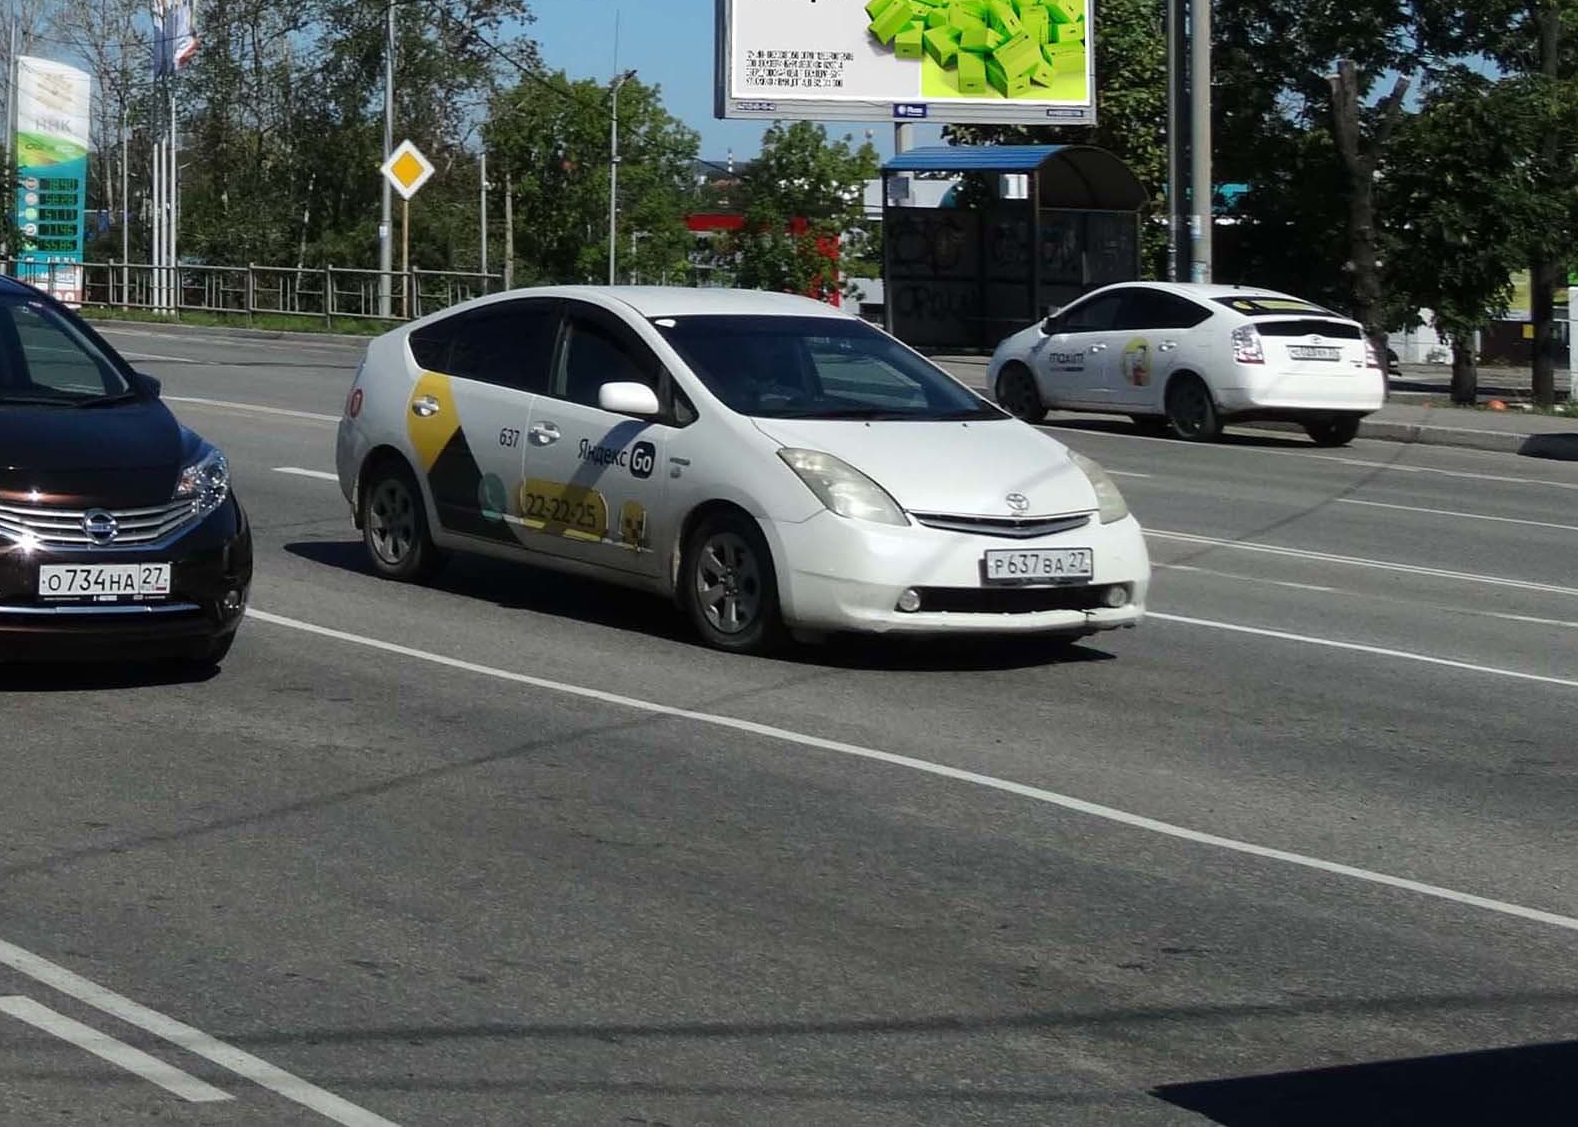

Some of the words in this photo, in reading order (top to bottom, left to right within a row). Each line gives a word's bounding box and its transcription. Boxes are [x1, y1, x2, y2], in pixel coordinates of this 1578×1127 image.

[499, 427, 520, 448] 637
[577, 429, 628, 467] Яндекс
[632, 448, 652, 473] Go
[525, 494, 597, 527] 22-22-25
